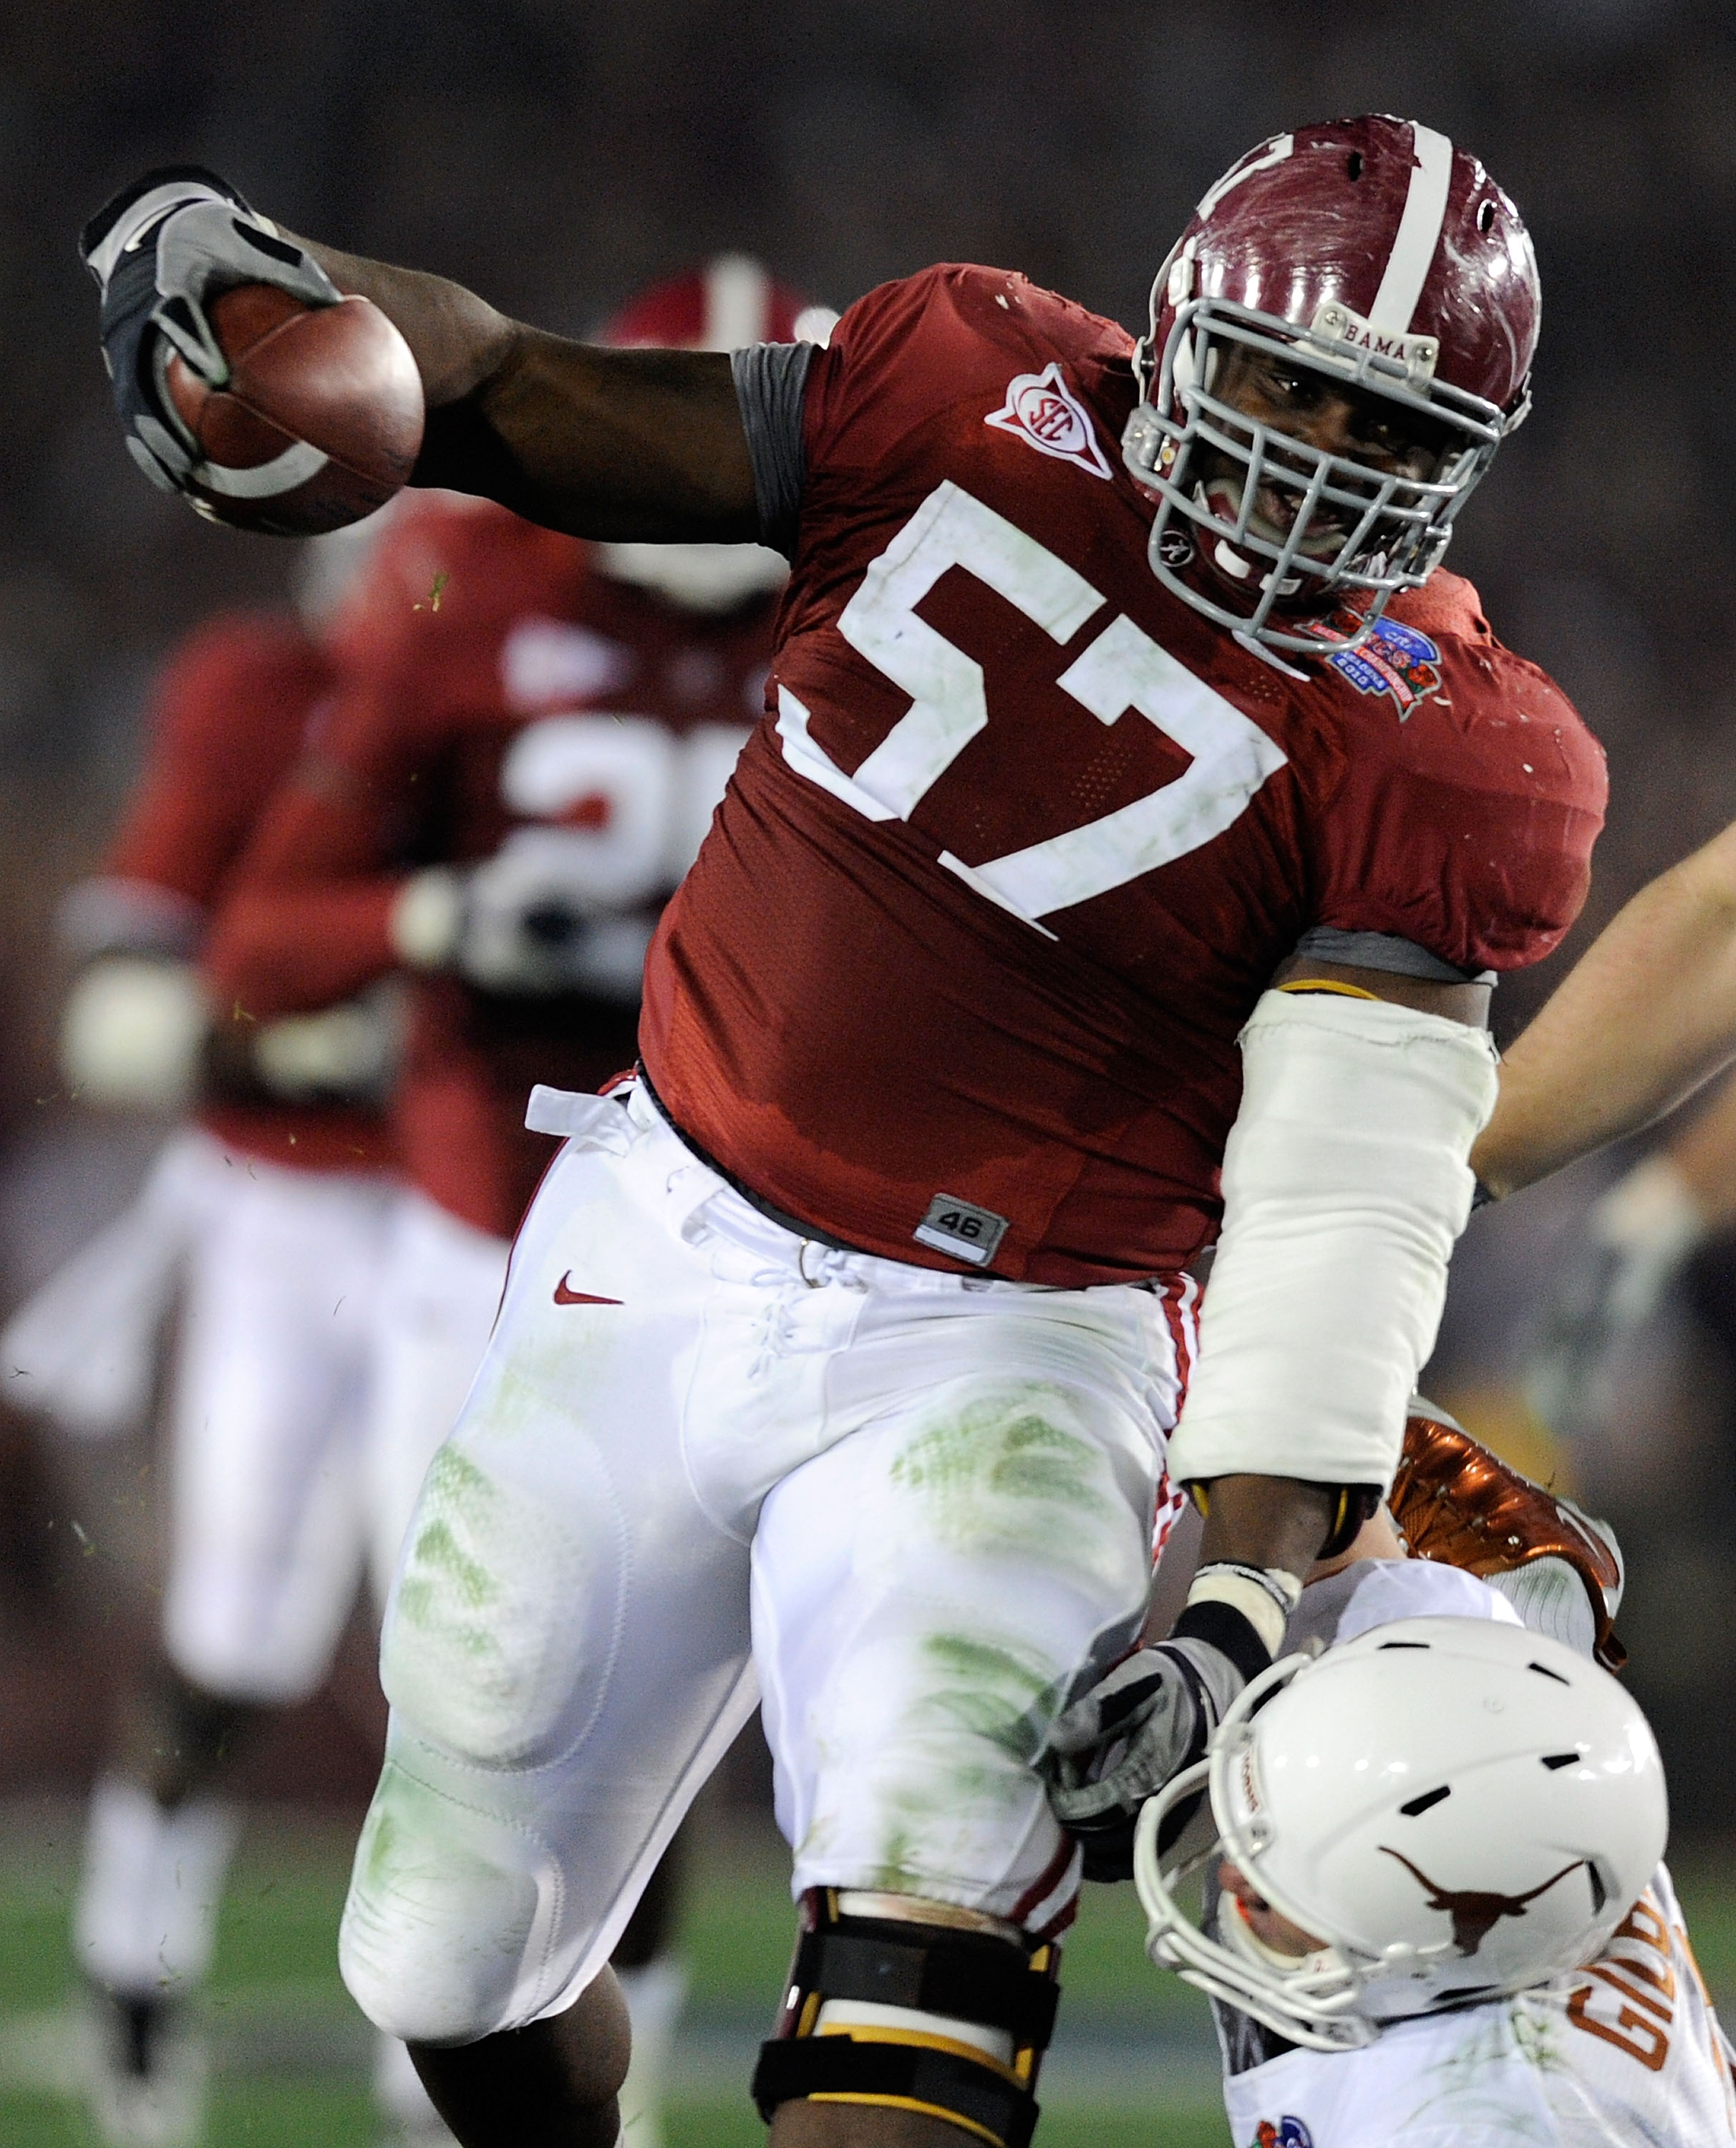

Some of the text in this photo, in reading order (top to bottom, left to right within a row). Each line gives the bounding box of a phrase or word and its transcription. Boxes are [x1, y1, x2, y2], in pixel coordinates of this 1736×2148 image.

[1344, 324, 1405, 359] BAMA
[1029, 397, 1073, 441] SEC
[775, 478, 1289, 942] 57
[937, 1211, 983, 1238] 46
